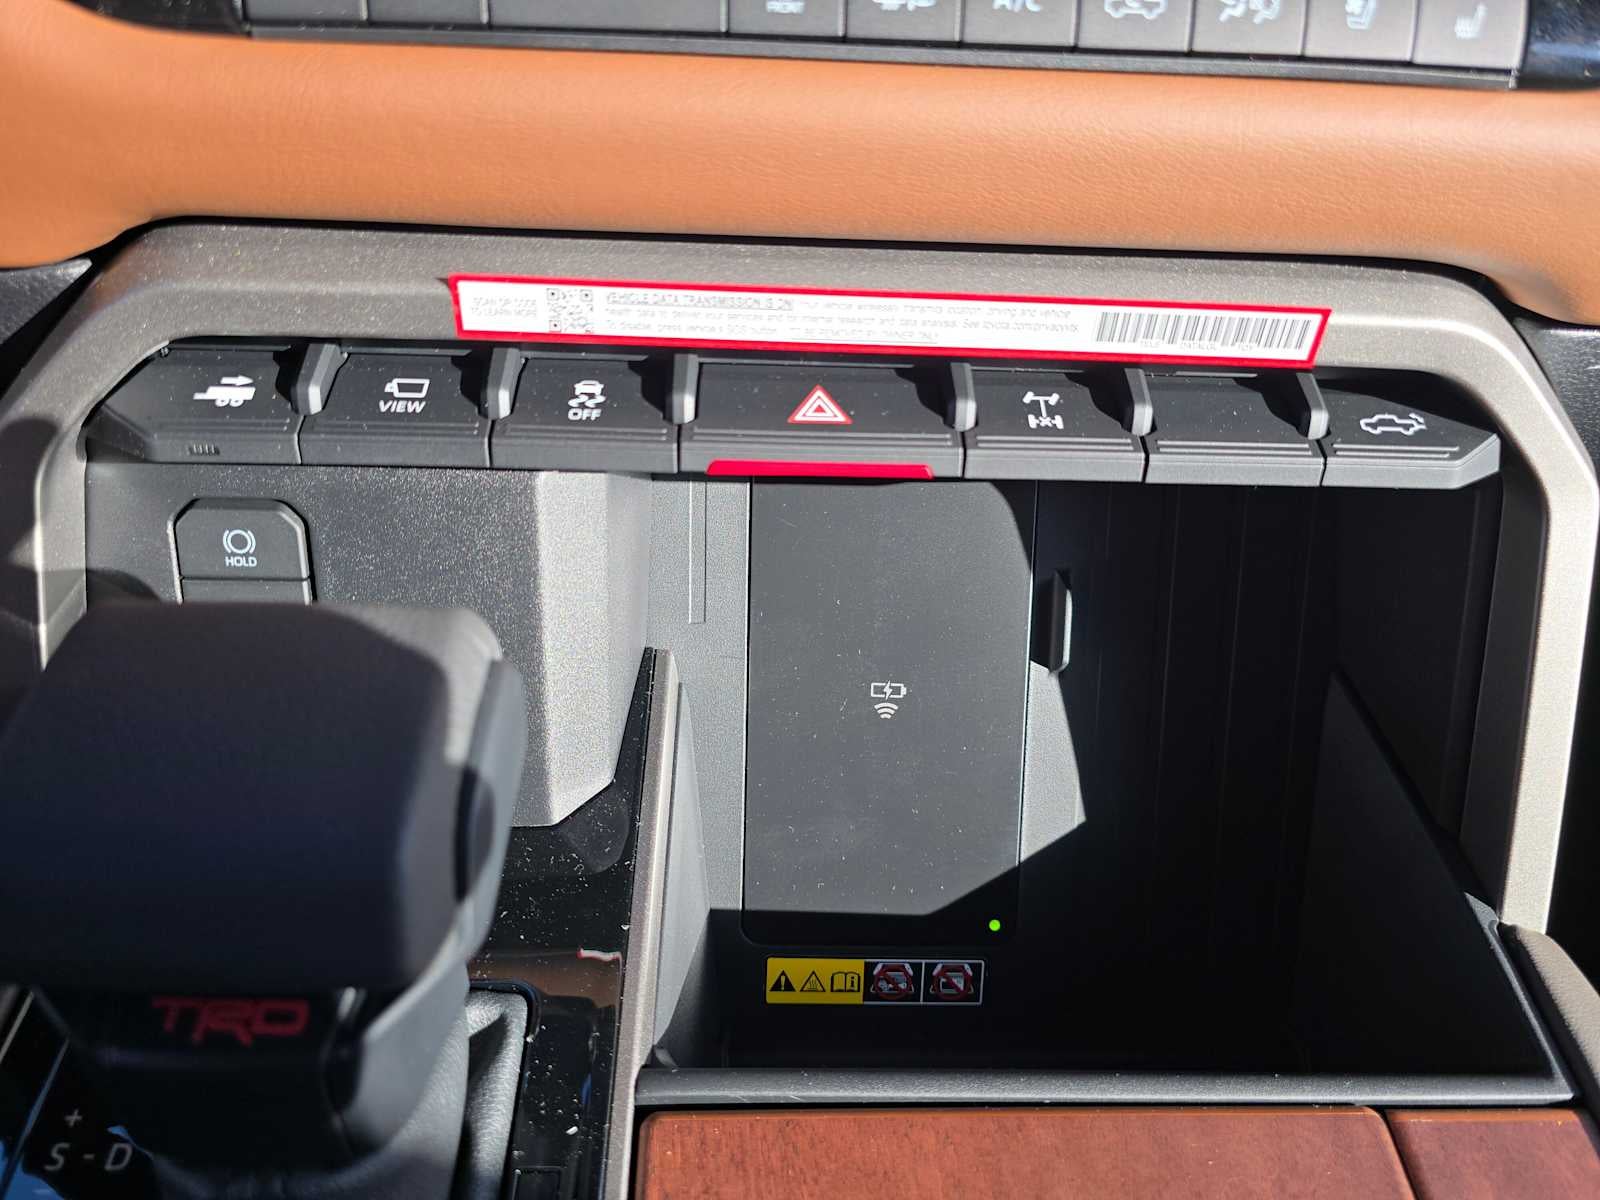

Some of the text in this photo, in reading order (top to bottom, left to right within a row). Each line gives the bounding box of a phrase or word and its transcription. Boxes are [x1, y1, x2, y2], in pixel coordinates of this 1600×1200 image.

[378, 400, 427, 414] VIEW
[567, 409, 602, 421] OFF
[224, 556, 258, 567] HOLD
[151, 997, 309, 1047] TRD
[44, 1142, 71, 1172] S
[103, 1142, 134, 1172] D
